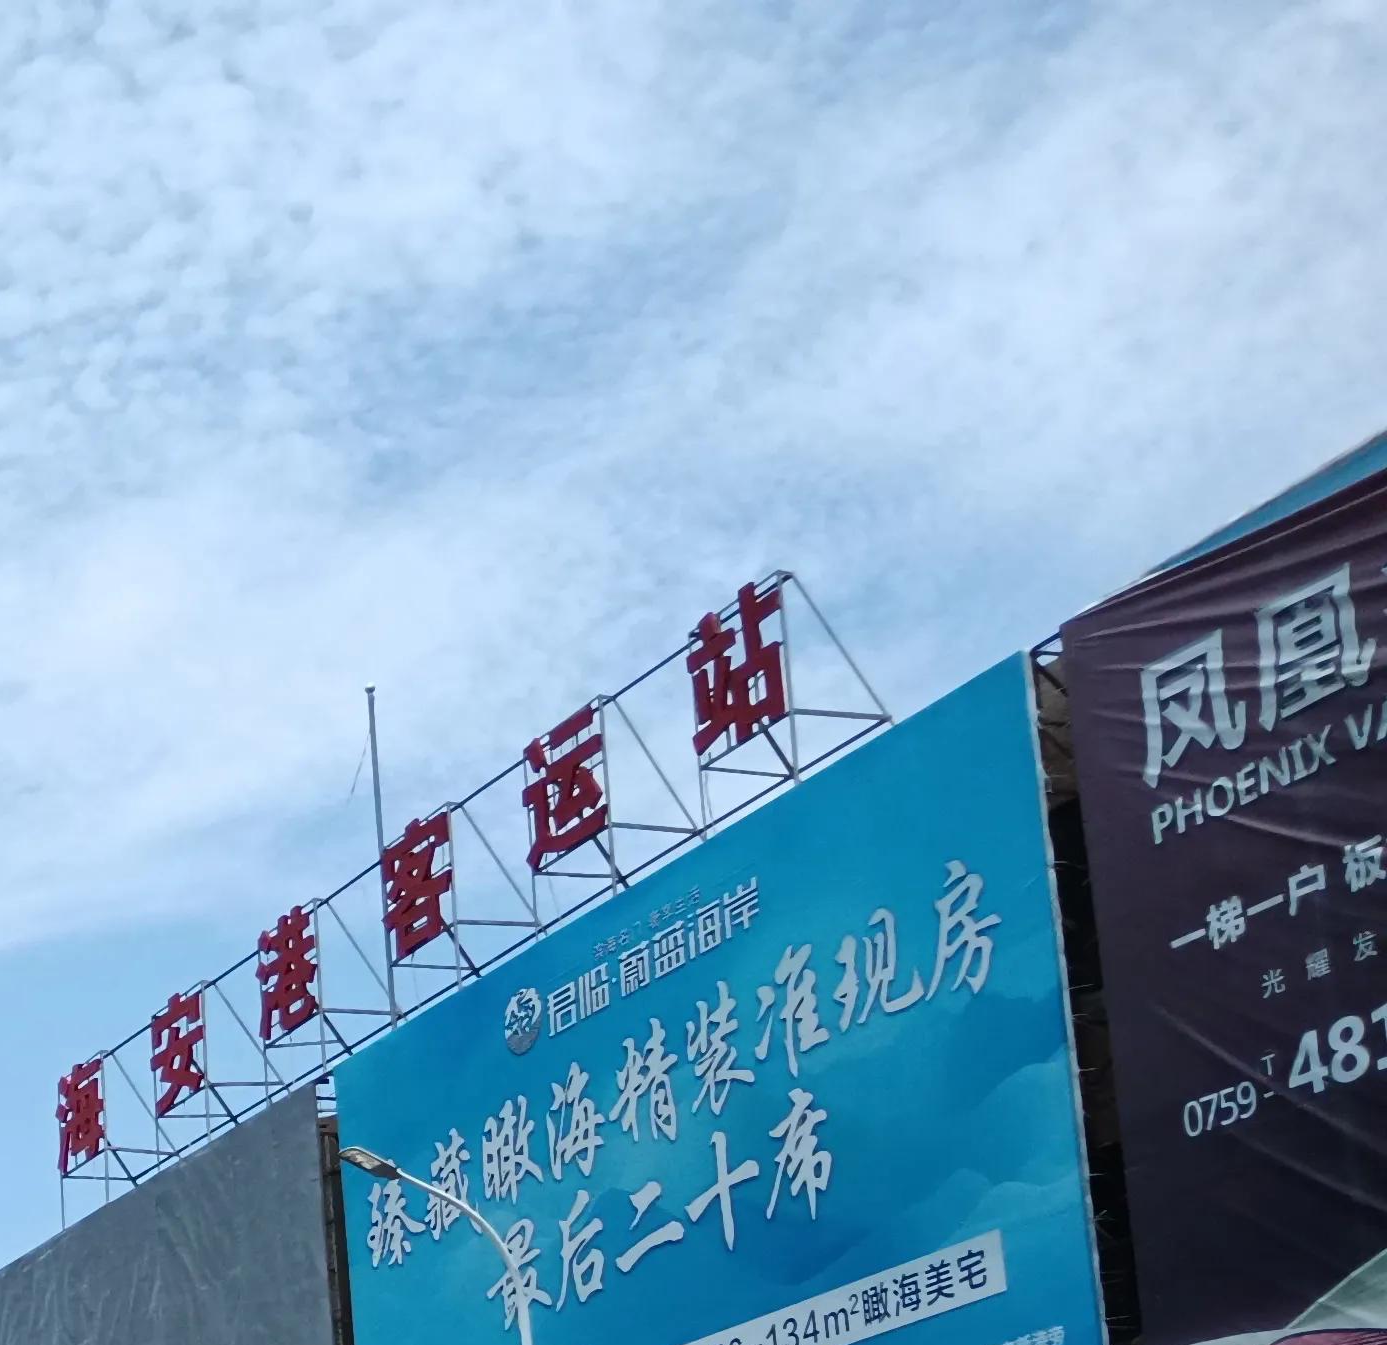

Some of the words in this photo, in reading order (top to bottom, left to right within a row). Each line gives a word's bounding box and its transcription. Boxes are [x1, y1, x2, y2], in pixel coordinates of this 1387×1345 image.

[1138, 562, 1387, 788] 凤凰
[1149, 724, 1337, 846] PHOENIX
[56, 581, 786, 1175] 海安港客运站
[1170, 864, 1326, 950] 一梯一户
[1183, 1081, 1257, 1137] 0759
[486, 1087, 833, 1331] 最后二十席
